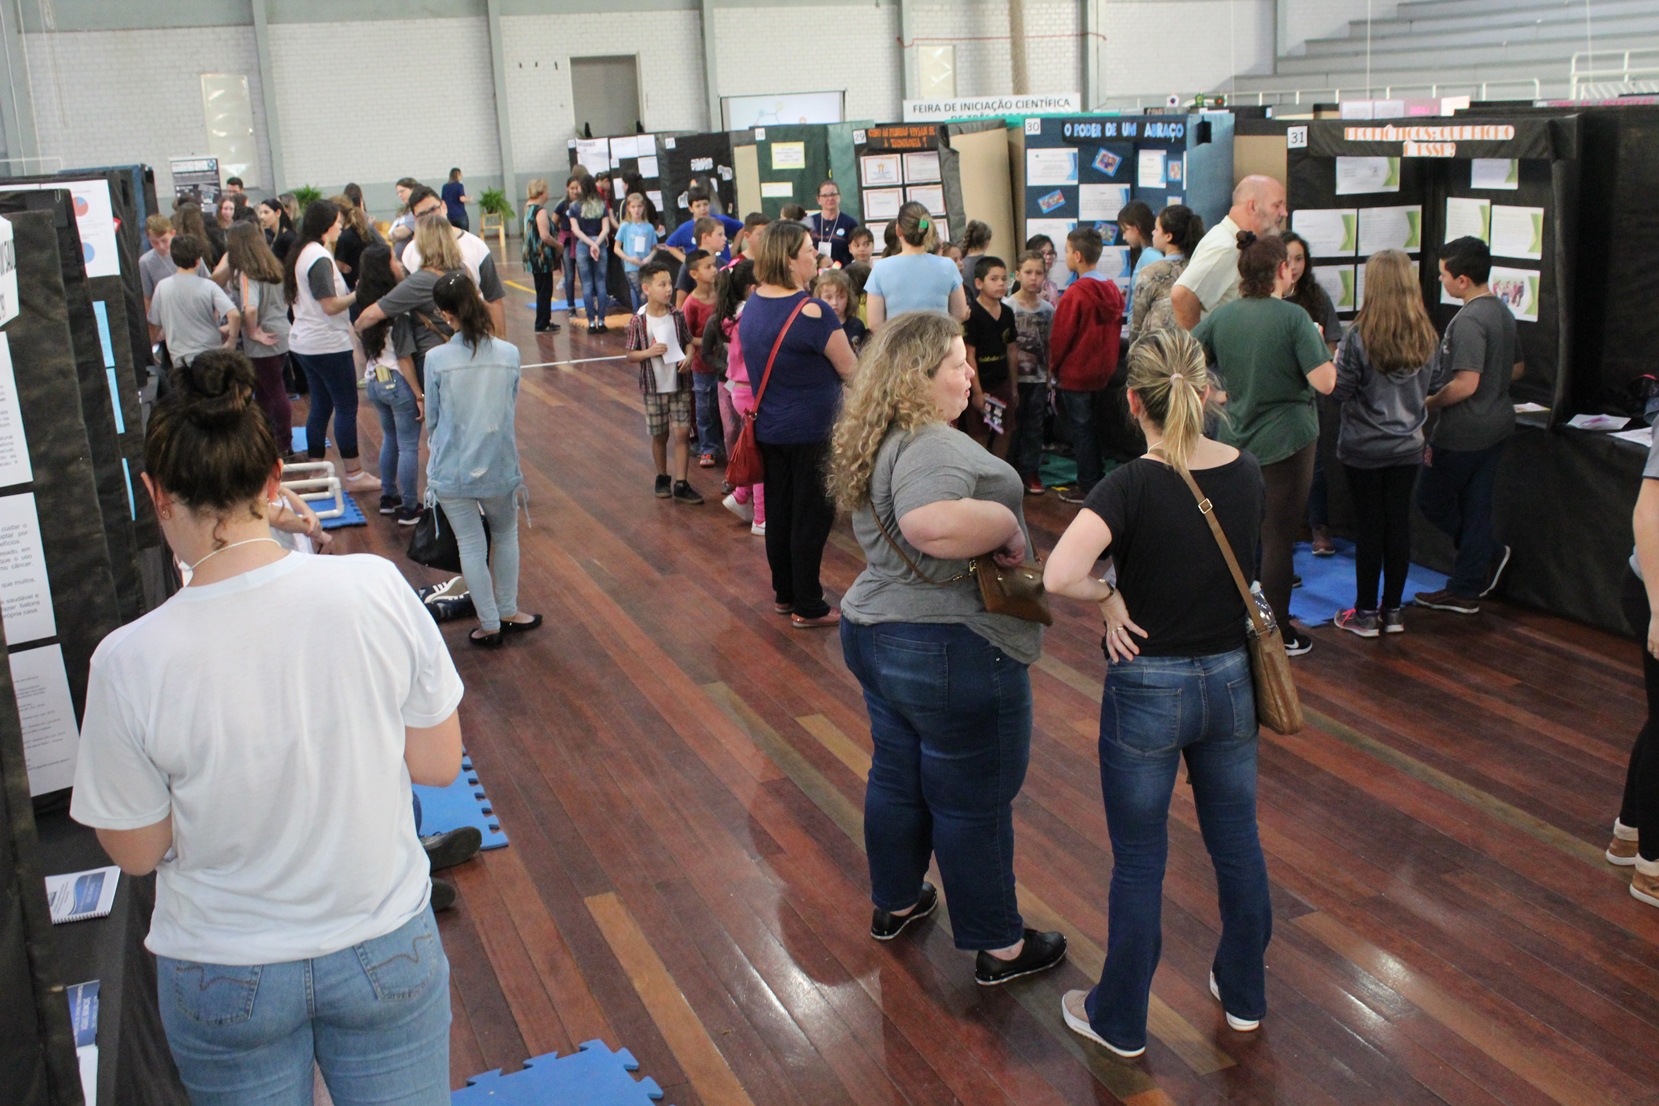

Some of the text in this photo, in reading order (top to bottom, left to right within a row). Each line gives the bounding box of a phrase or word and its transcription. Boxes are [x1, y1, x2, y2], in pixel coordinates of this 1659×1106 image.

[912, 96, 1071, 114] FEIRA DE INICIAÇÃO CIENTÍFICA
[1027, 122, 1040, 132] 30
[1064, 121, 1185, 142] O PODER DE UM ABRAÇO
[854, 132, 866, 142] 29
[1290, 132, 1304, 144] 31
